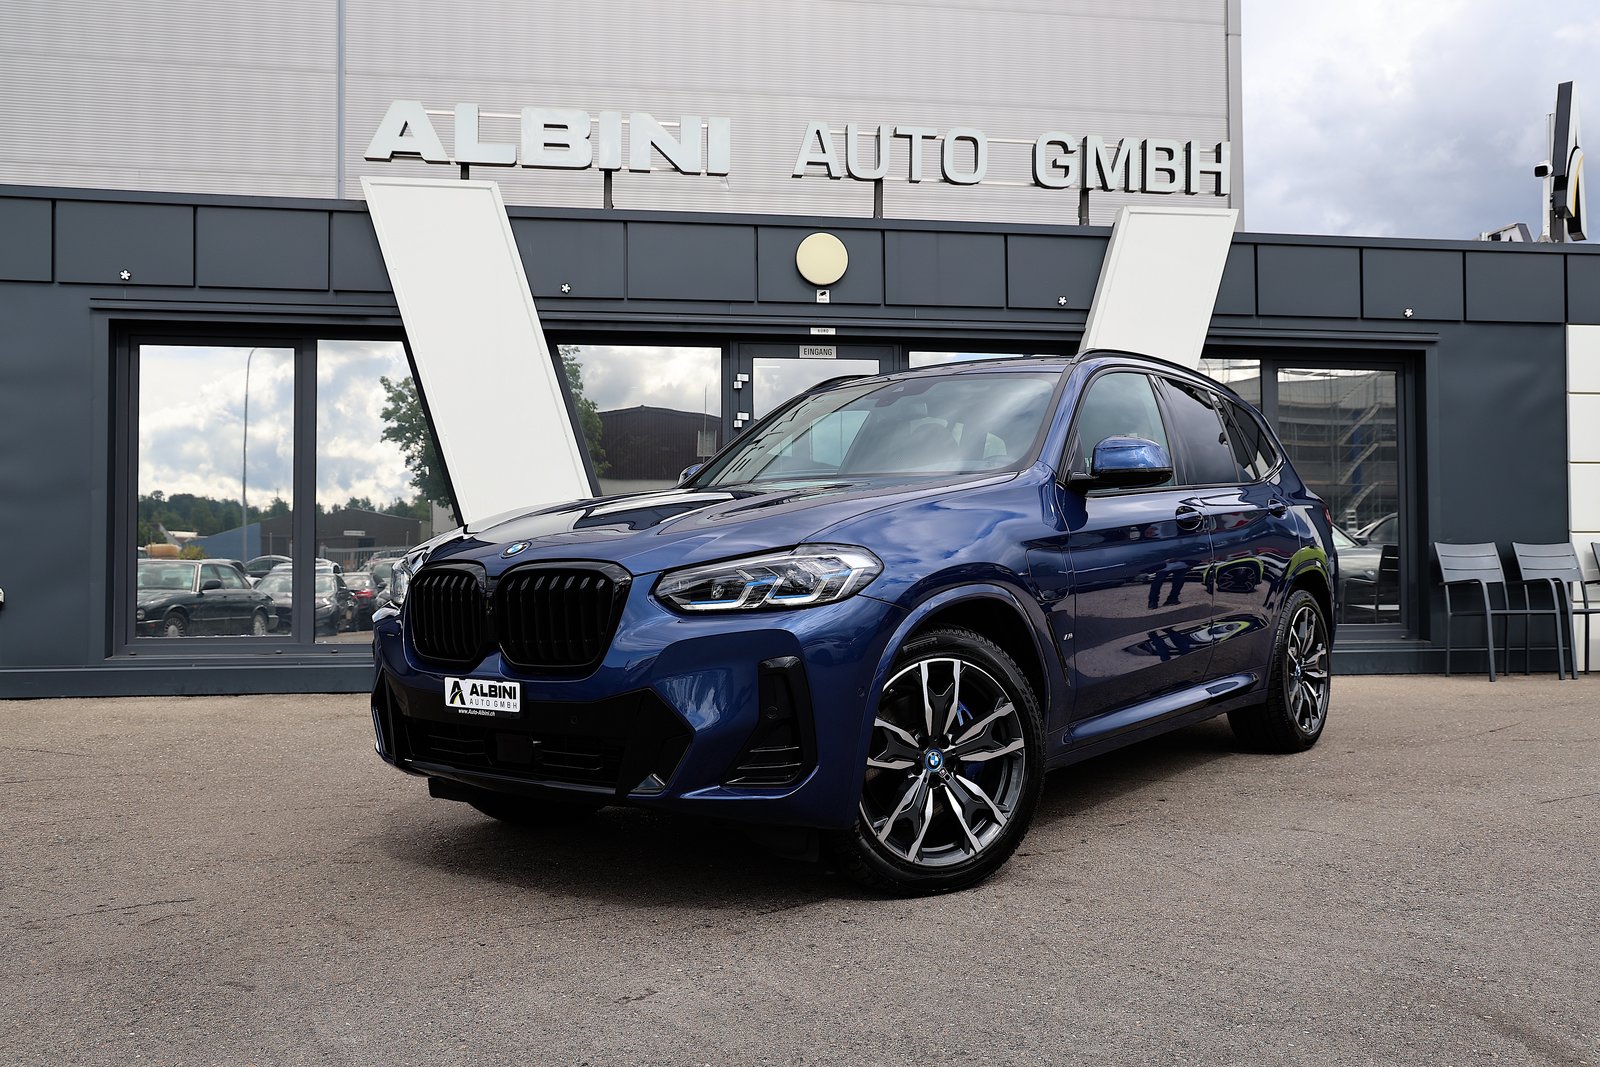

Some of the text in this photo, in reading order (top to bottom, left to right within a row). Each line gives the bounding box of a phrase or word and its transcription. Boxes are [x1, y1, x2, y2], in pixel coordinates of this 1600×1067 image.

[363, 99, 1231, 196] ALBINI AUTO GMBH
[803, 347, 833, 356] EINGANG
[469, 683, 517, 700] ALBINI
[469, 698, 518, 709] AUTO GMBH
